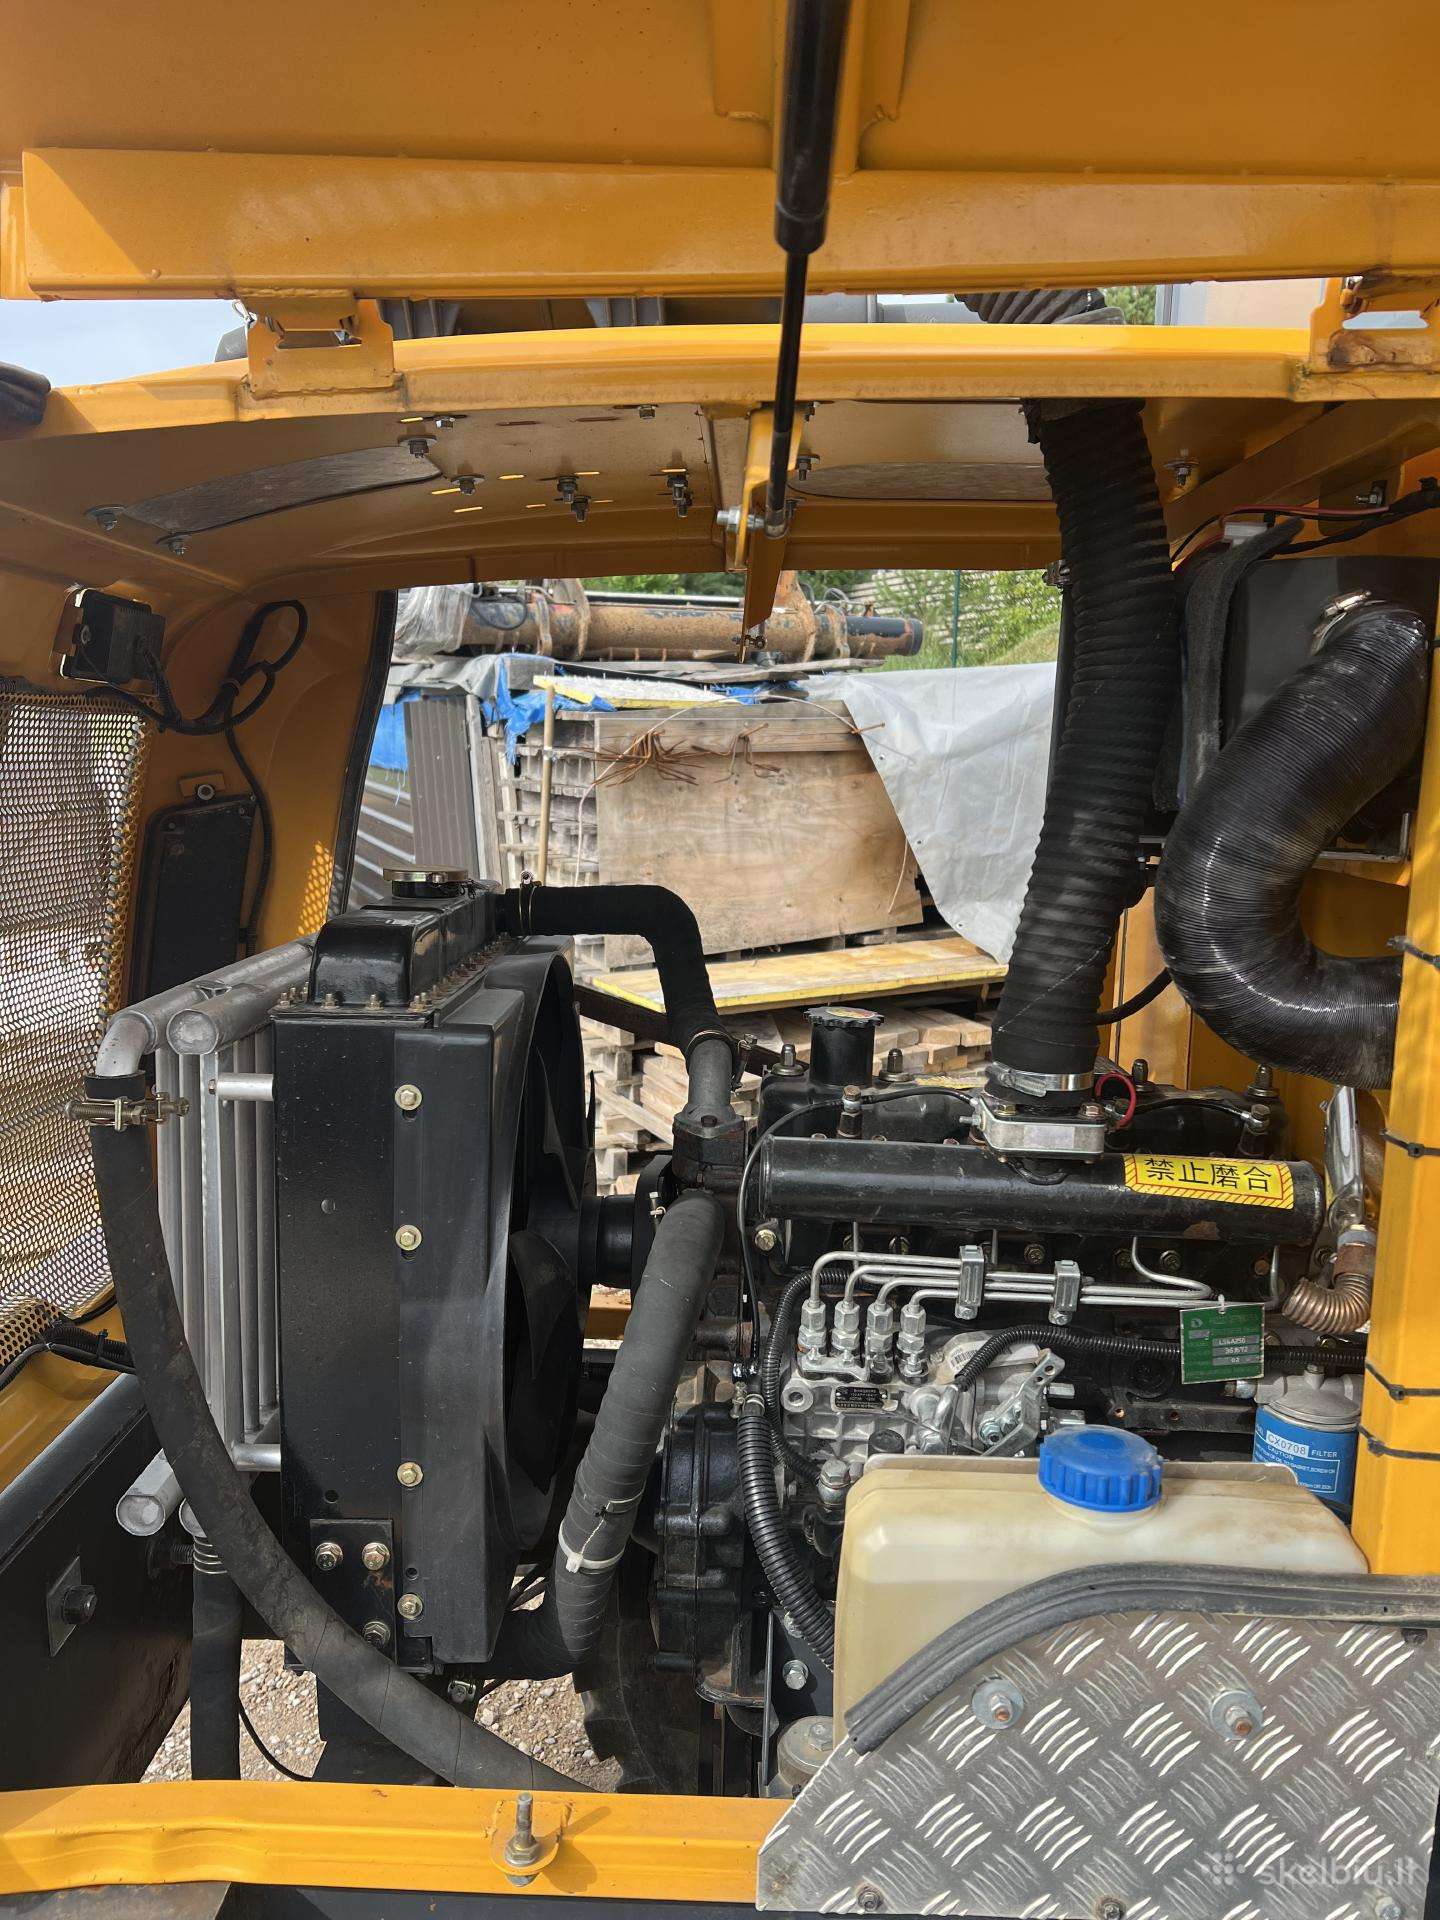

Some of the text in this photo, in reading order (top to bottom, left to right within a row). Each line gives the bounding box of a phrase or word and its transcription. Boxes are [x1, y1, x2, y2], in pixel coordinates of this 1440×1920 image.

[1144, 1158, 1272, 1193] 禁止磨合
[1267, 1445, 1294, 1461] CAUTION
[1268, 1433, 1306, 1455] CX0708
[1311, 1449, 1337, 1458] FILTER
